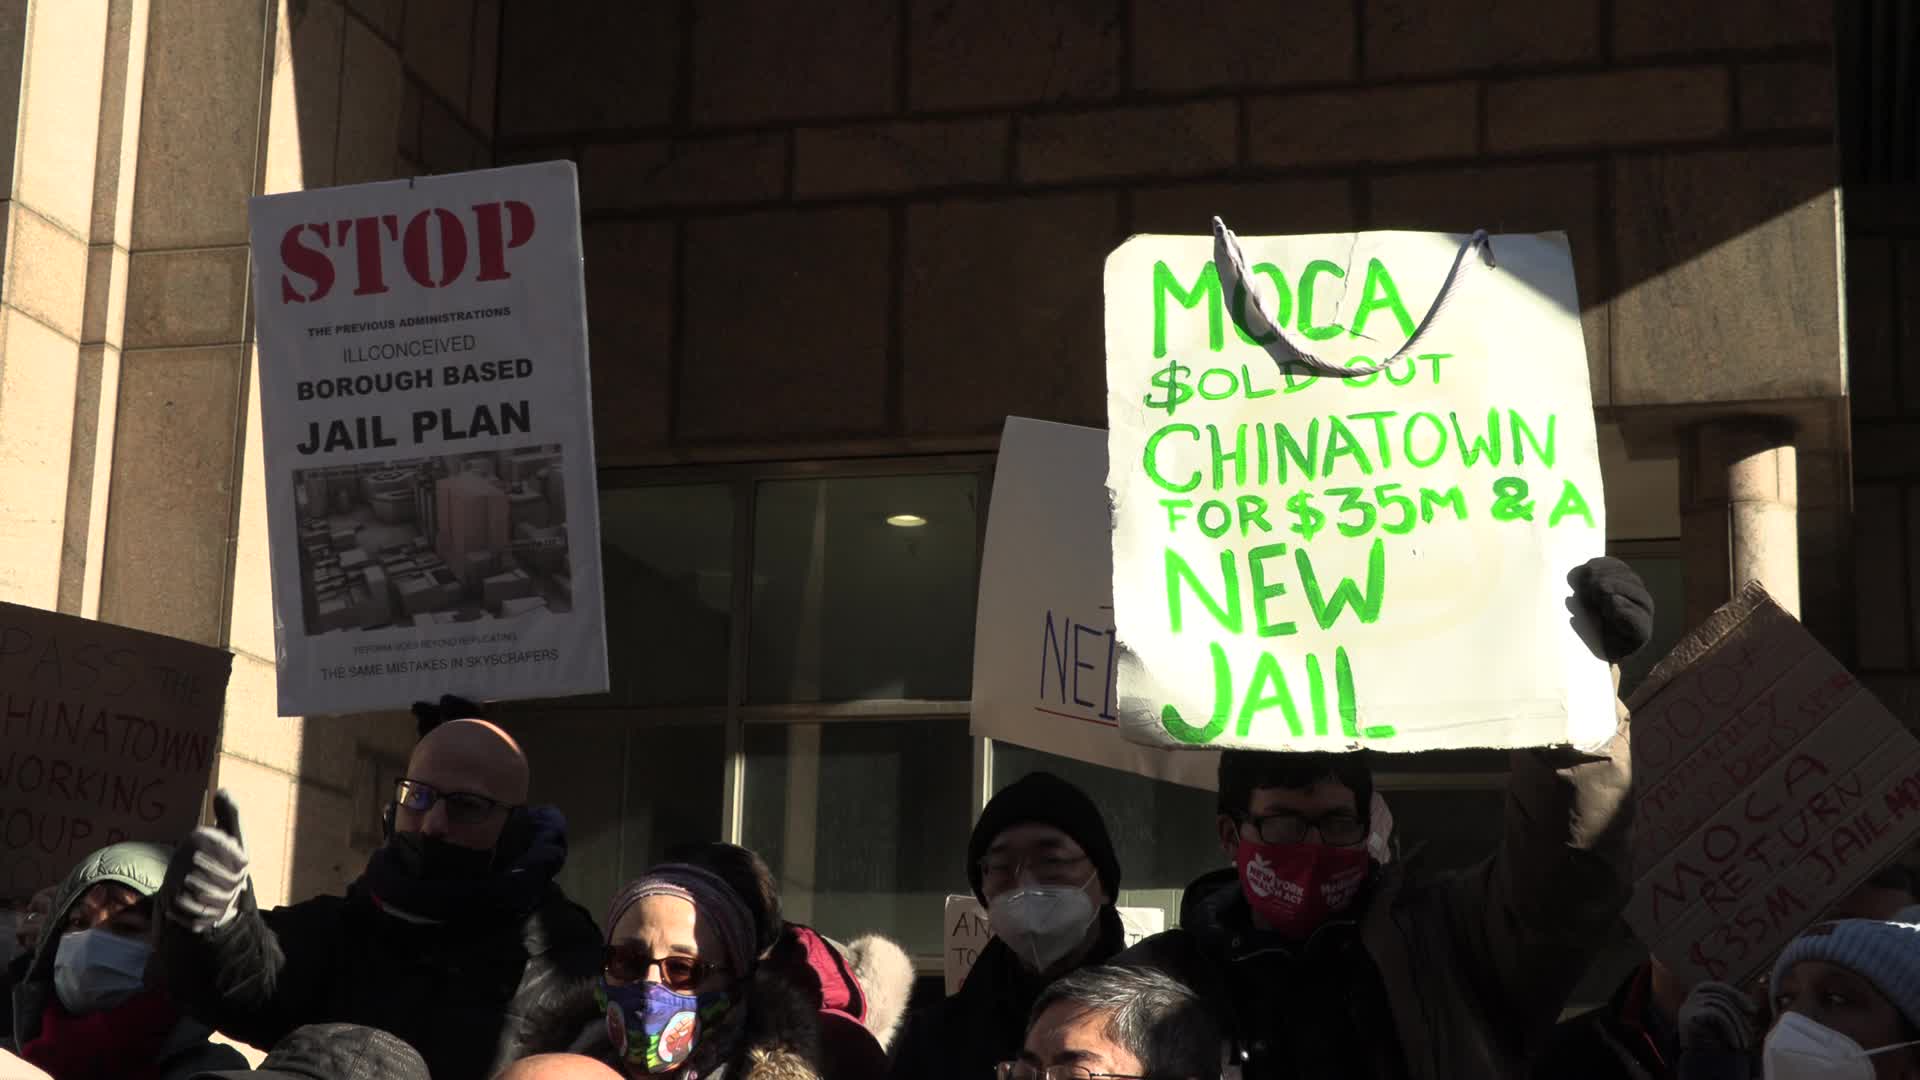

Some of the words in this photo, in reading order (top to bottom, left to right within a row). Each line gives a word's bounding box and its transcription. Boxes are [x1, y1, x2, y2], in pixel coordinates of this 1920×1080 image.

[280, 201, 535, 304] STOP
[308, 326, 332, 337] THE
[335, 319, 395, 334] PREVIOUS
[399, 307, 511, 328] ADMINISTRATIONS
[1154, 257, 1417, 358] MOCA
[297, 368, 433, 401] BOROUGH
[443, 358, 533, 387] BASED
[343, 334, 476, 363] ILLCONCEIVED
[1341, 353, 1455, 388] OUT
[297, 415, 396, 455] JAIL
[412, 401, 531, 444] PLAN
[1143, 408, 1556, 493] CHINATOWN
[1159, 495, 1273, 538] FOR
[1286, 483, 1469, 541] $35M
[1491, 477, 1537, 523] &
[1548, 480, 1597, 529] A
[1165, 538, 1386, 637] NEW
[0, 626, 138, 697] PASS
[320, 665, 345, 681] THE
[348, 663, 384, 678] SAME
[386, 658, 448, 675] MISTAKES
[451, 657, 464, 669] IN
[466, 649, 560, 669] SKYSCRAPERS
[1161, 641, 1396, 744] JAIL
[2, 695, 208, 774] HINATOWN
[0, 807, 93, 856] OUP
[1652, 754, 1829, 927] MOCA
[1699, 771, 1863, 913] RETURN
[1798, 809, 1889, 886] JAIL
[1275, 878, 1304, 897] YORK
[1283, 892, 1303, 905] ACT
